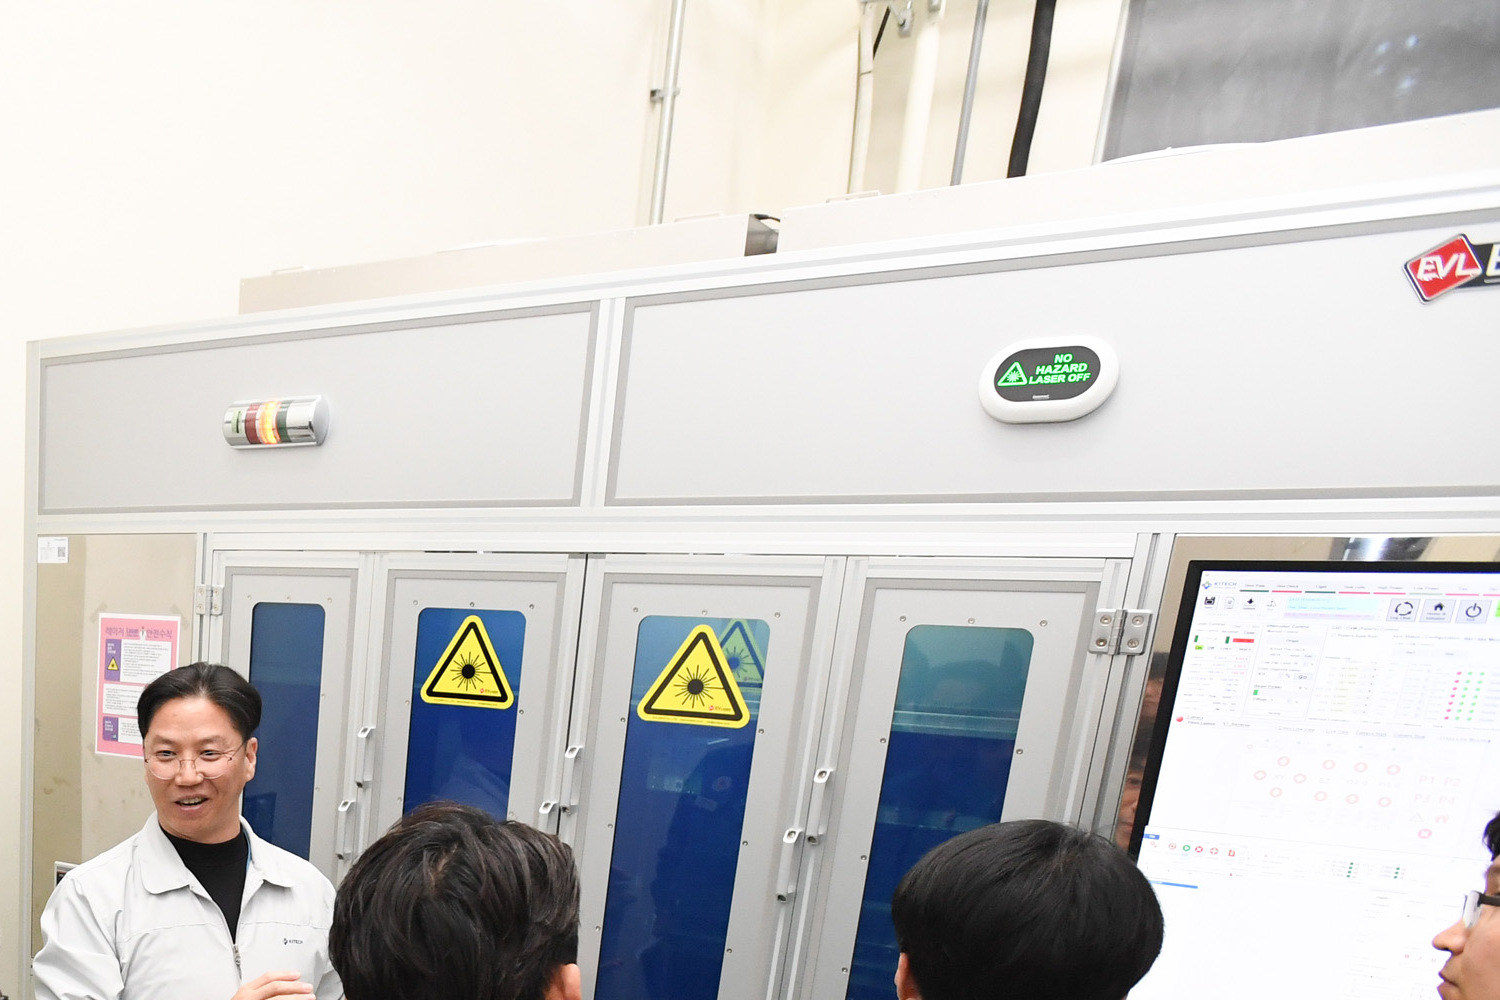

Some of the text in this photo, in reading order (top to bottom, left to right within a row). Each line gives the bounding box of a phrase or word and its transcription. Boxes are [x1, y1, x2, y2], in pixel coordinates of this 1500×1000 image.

[1417, 252, 1482, 281] EVL
[1054, 353, 1073, 364] NO
[1035, 362, 1088, 375] HAZARD
[1028, 372, 1091, 385] LASER OFF
